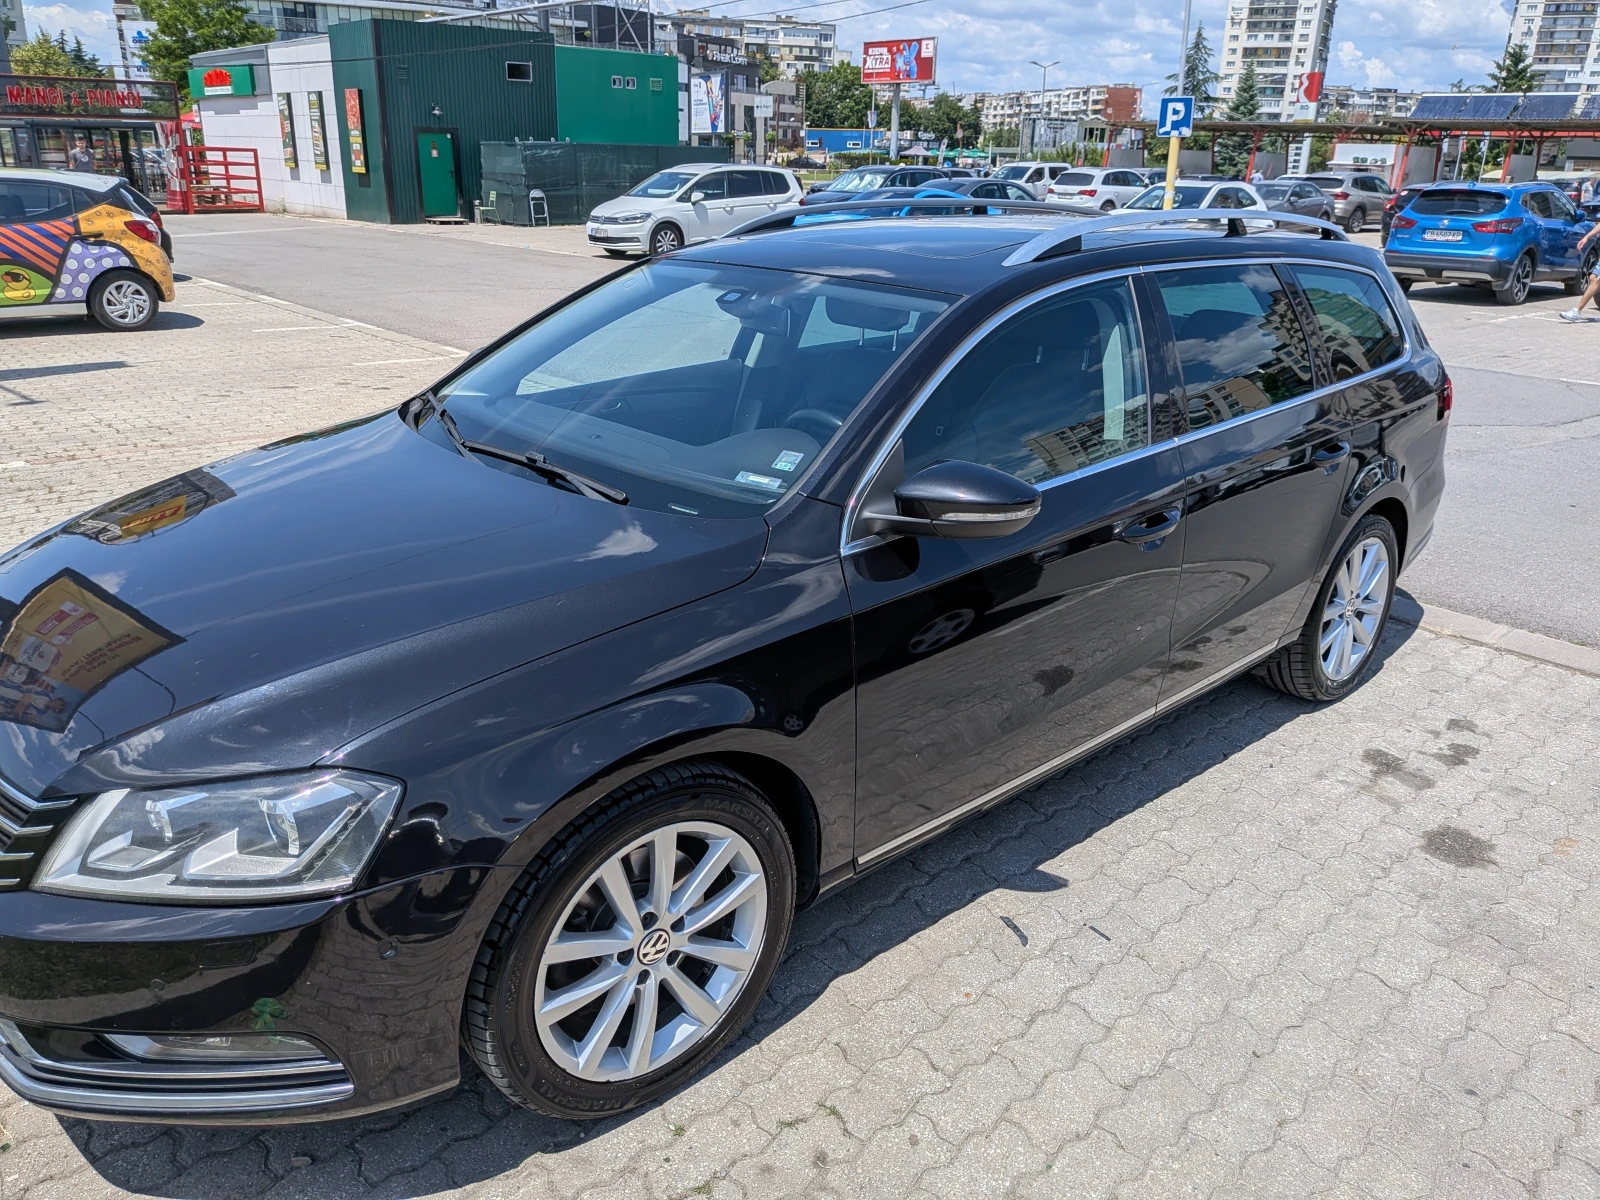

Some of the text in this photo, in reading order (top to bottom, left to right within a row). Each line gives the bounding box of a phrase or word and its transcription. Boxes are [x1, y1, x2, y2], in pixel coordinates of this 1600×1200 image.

[864, 55, 890, 69] XTRA
[6, 85, 142, 108] MANGI & PIANGI
[1162, 102, 1186, 132] P
[703, 797, 771, 840] MARSHAL
[538, 1079, 622, 1111] MARSHAL
